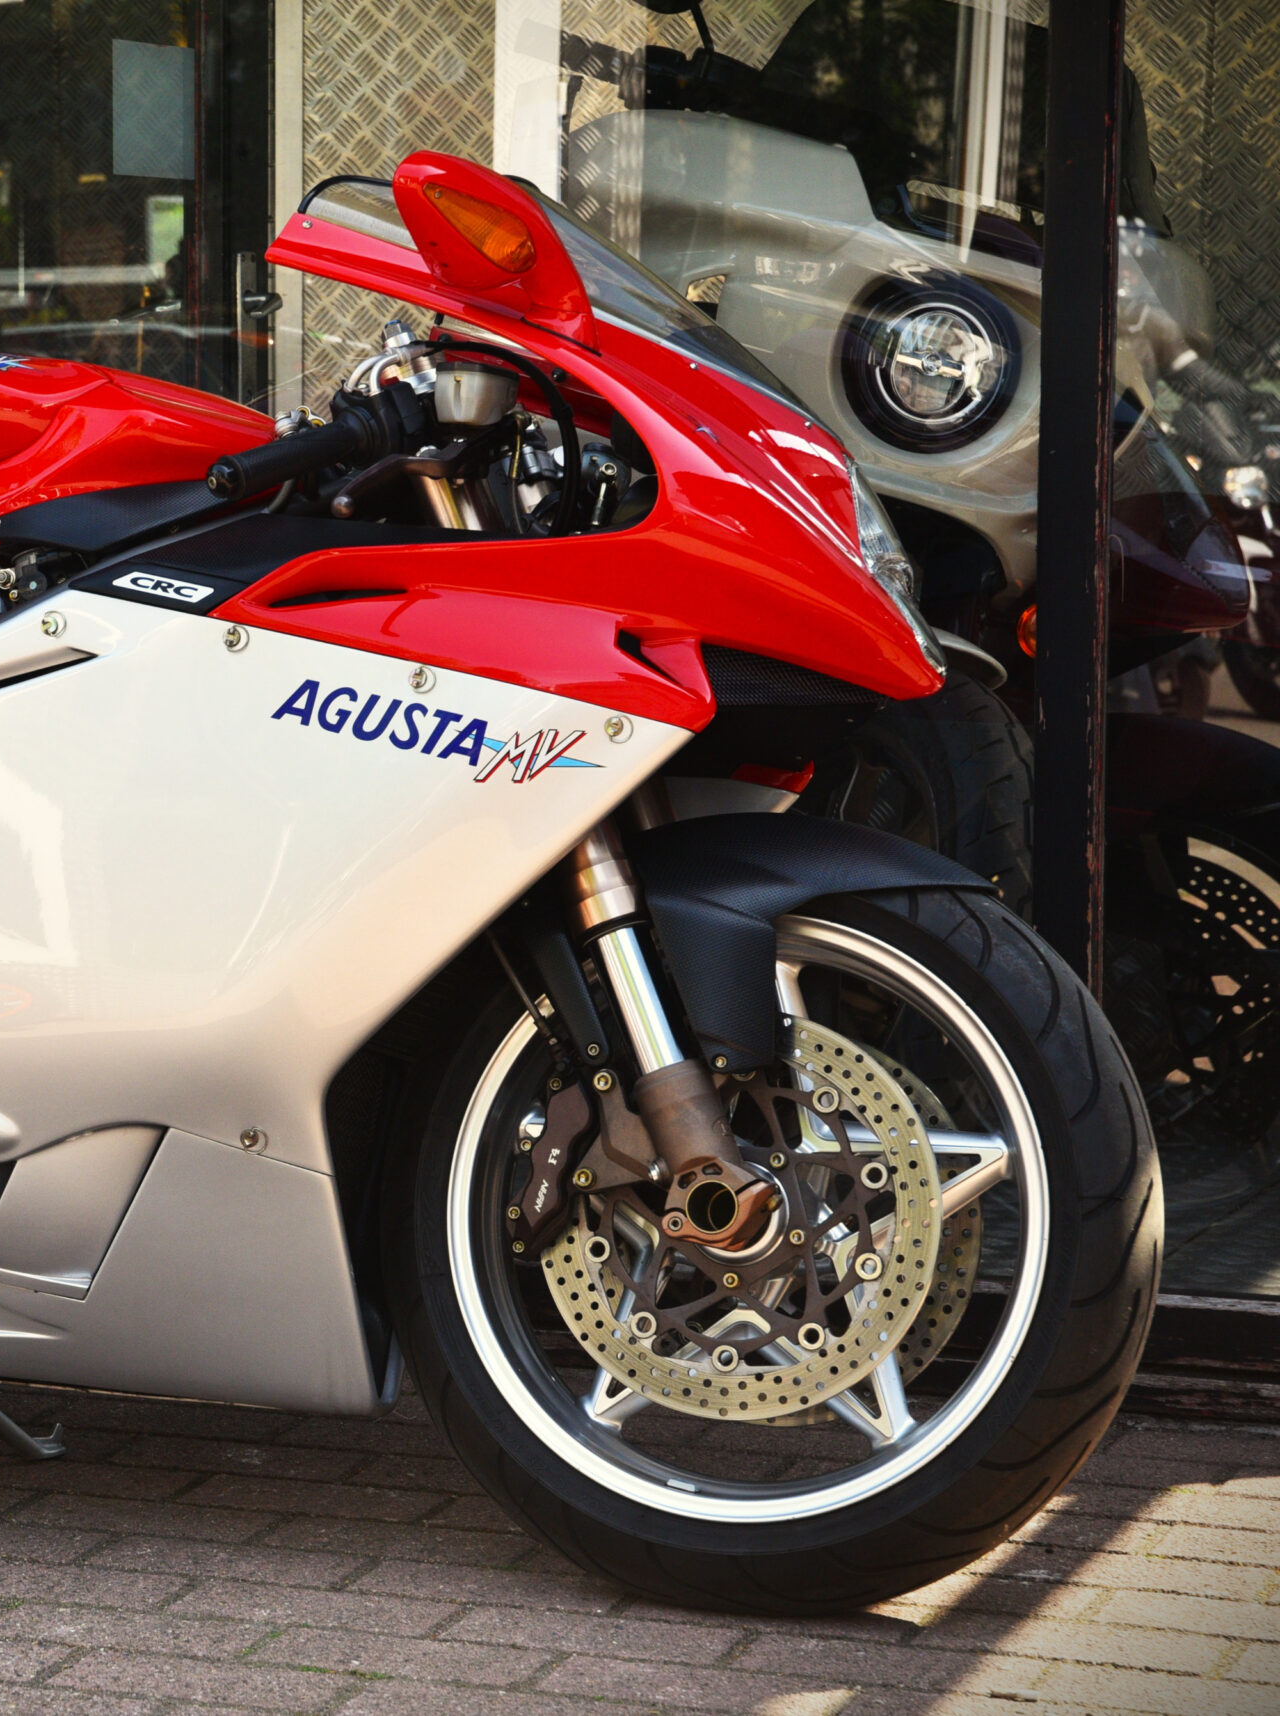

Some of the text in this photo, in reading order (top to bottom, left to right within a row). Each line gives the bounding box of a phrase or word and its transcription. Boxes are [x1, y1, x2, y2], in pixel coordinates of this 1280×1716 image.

[130, 576, 198, 598] CRC
[271, 679, 586, 783] AGUSTA MV
[547, 1147, 561, 1166] F4
